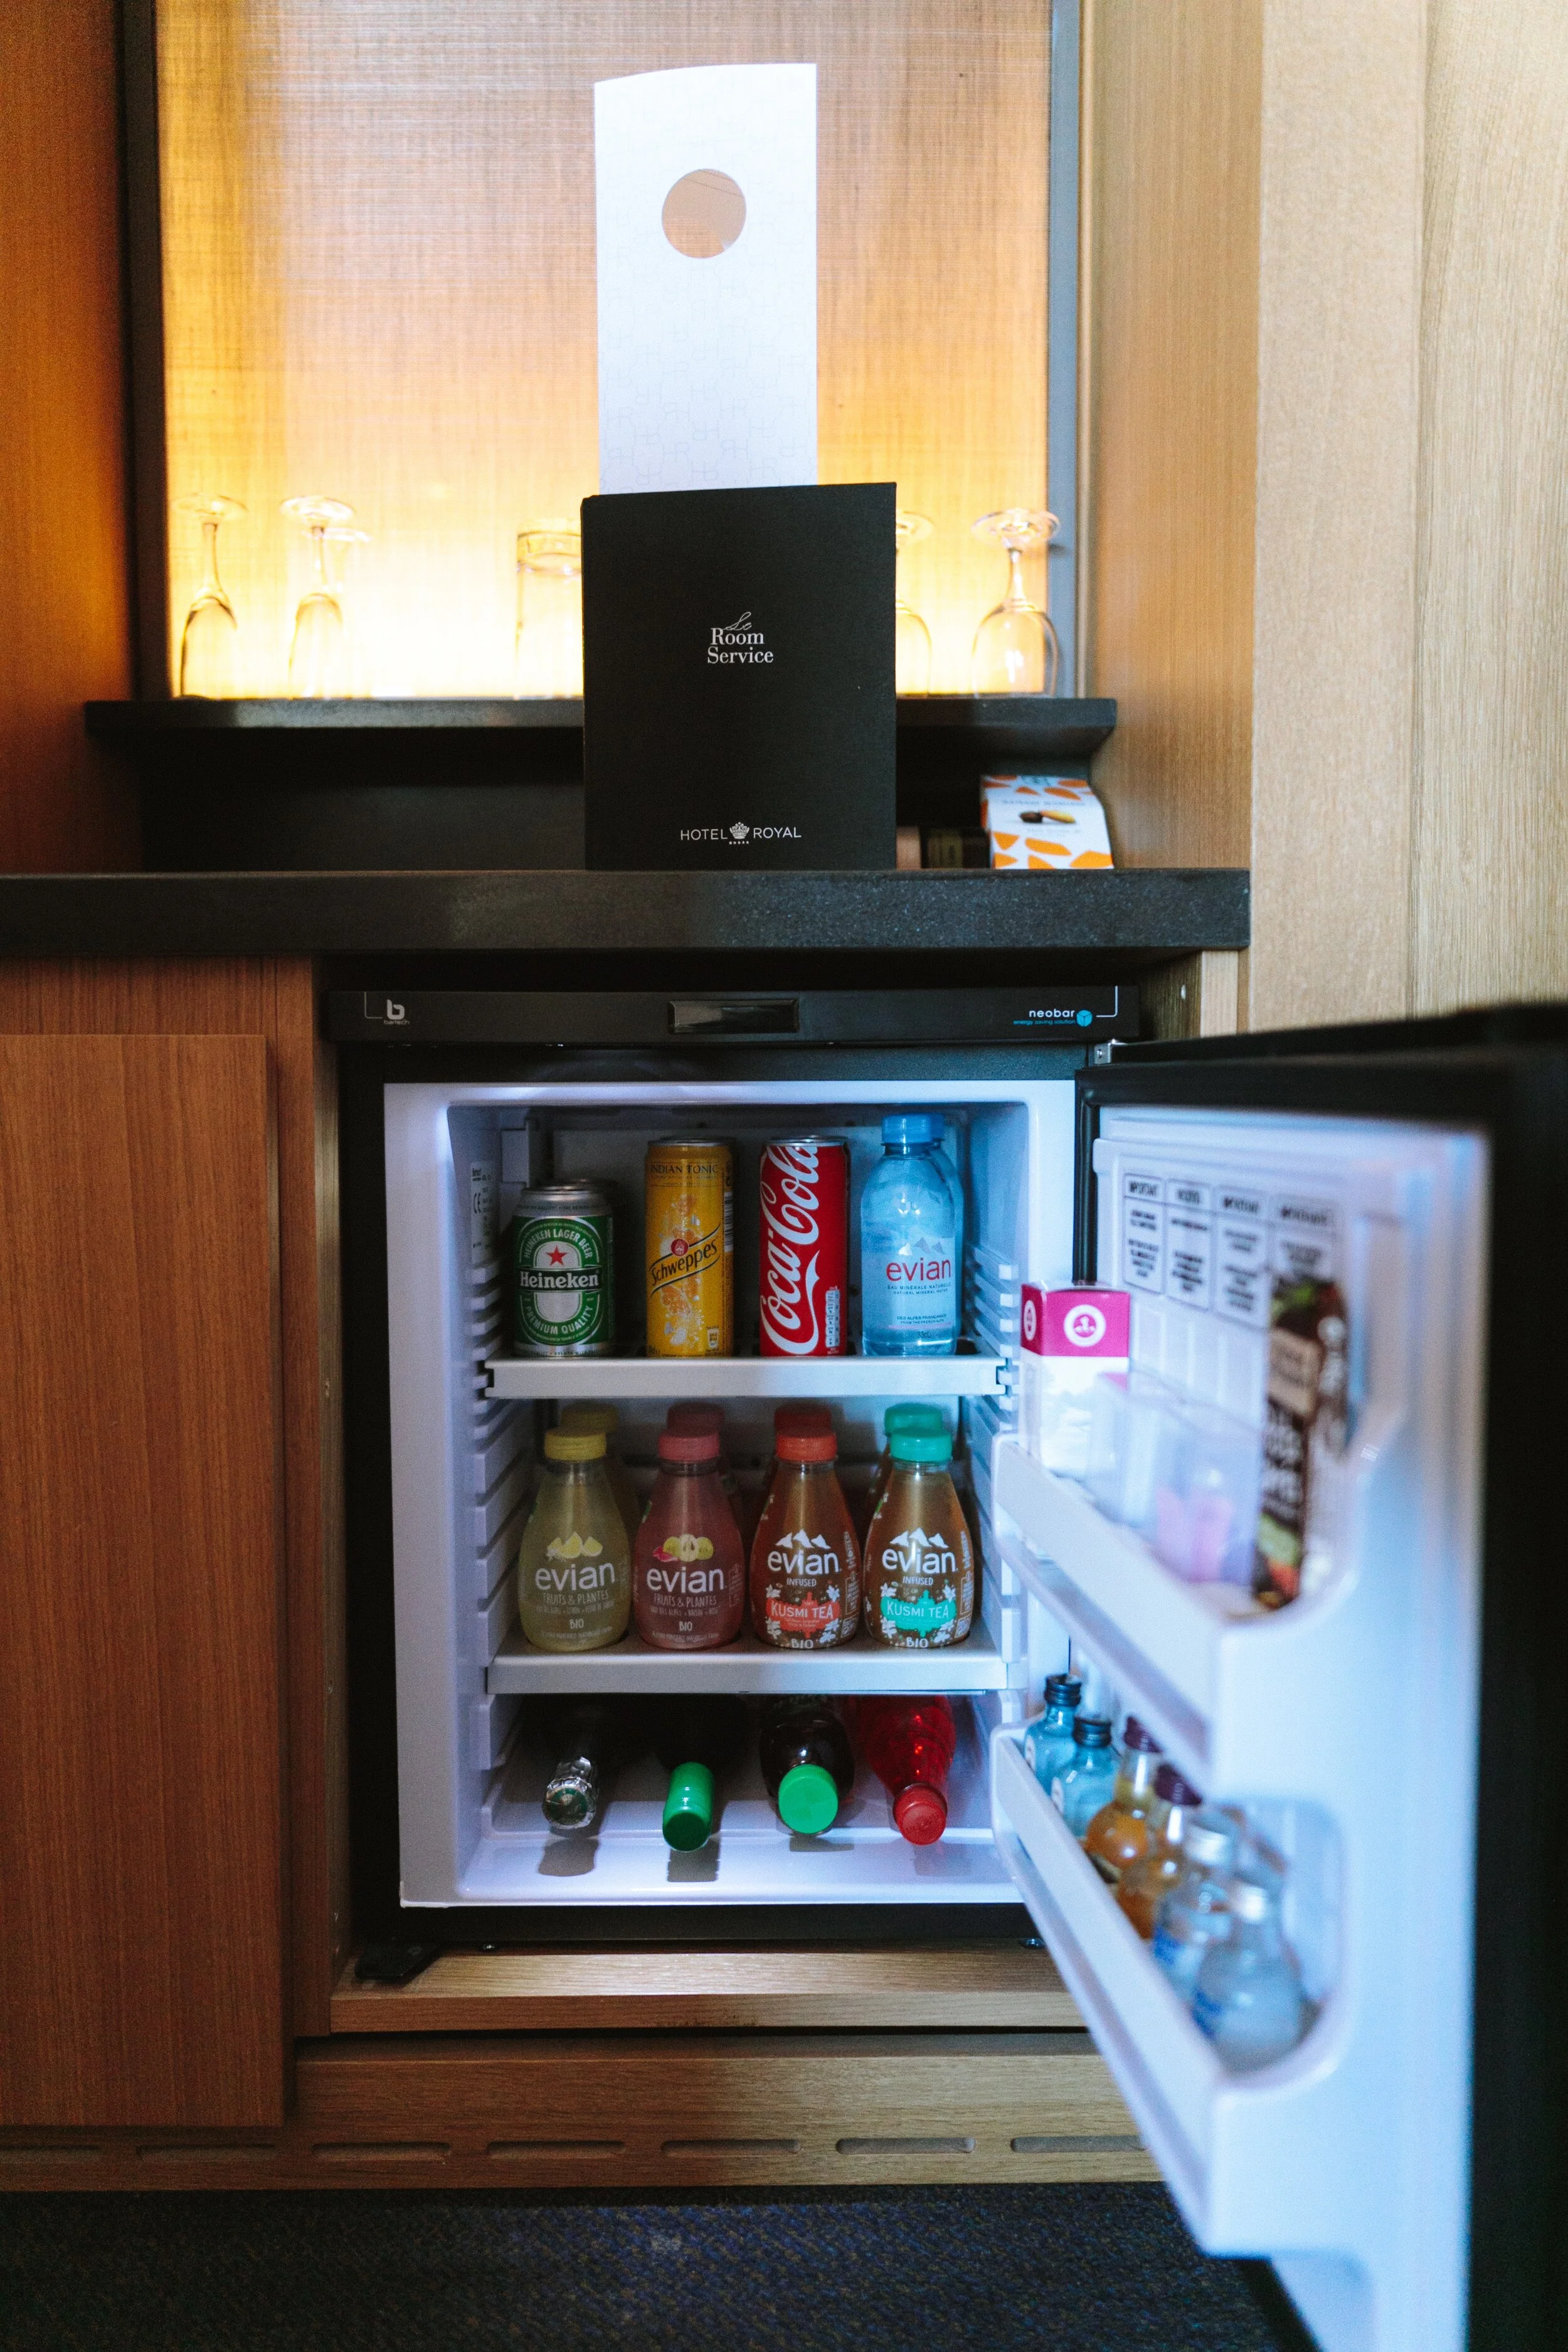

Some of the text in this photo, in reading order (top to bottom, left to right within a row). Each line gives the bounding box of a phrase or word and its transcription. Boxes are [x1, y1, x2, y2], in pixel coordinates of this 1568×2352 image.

[723, 612, 753, 630] Le
[711, 628, 765, 645] Room
[707, 646, 773, 664] Service
[681, 827, 802, 840] HOTEL ROYAL
[1029, 1009, 1075, 1017] neobar
[651, 1164, 718, 1174] INDIAN TONIC
[524, 1229, 593, 1259] HEINEKEN LAGER BEER
[760, 1145, 820, 1355] Coca-Cola
[651, 1239, 717, 1286] Schweppes
[886, 1257, 951, 1281] evian
[520, 1271, 599, 1288] Heineken
[526, 1305, 593, 1335] PREMIUM QUALITY
[768, 1550, 839, 1575] evian
[882, 1548, 956, 1574] evian
[535, 1562, 615, 1591] evian
[647, 1566, 724, 1593] evian
[787, 1578, 817, 1587] INFUSED
[903, 1576, 933, 1586] INFUSED
[543, 1590, 608, 1605] FRUITS & PLANTES
[654, 1594, 717, 1608] FRUITS & PLANTES
[771, 1601, 833, 1618] KUSMI TEA
[887, 1601, 948, 1618] KUSMI TEA
[569, 1618, 584, 1629] BIO
[679, 1621, 692, 1631] BIO
[791, 1638, 813, 1648] BIO
[906, 1637, 928, 1648] BIO
